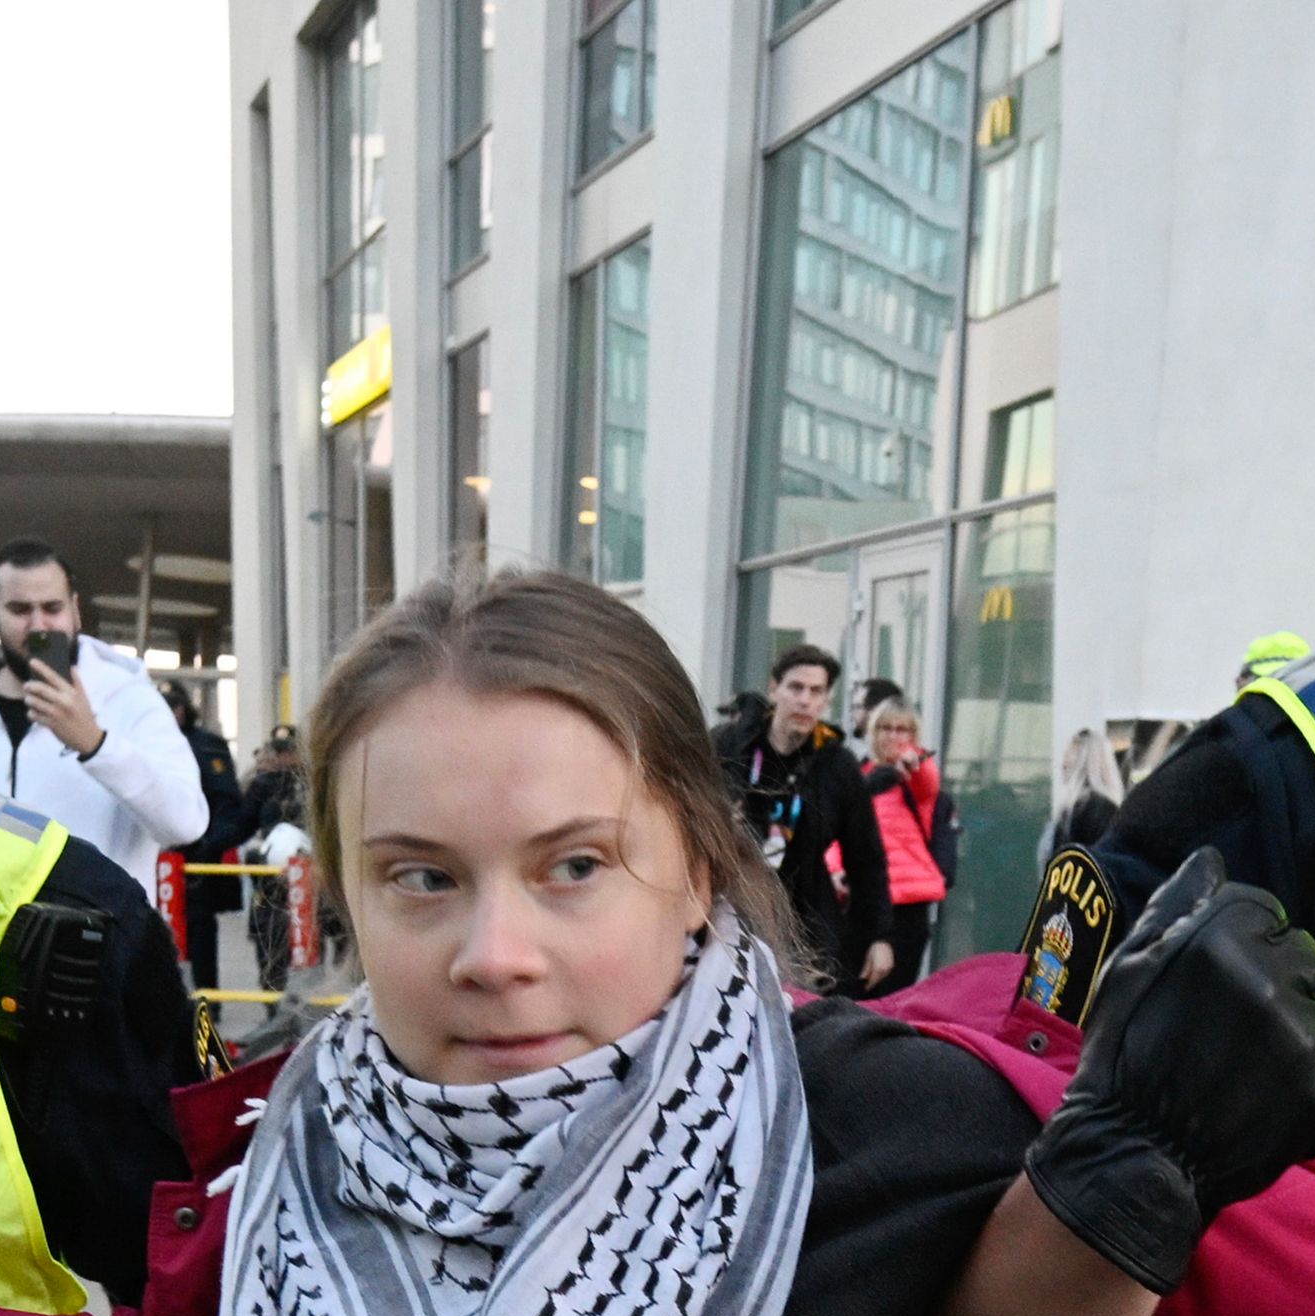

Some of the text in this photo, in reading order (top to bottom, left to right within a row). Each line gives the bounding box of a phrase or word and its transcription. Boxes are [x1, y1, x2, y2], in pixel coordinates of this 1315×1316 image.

[158, 861, 174, 924] POL
[287, 865, 306, 965] POLIS
[1047, 861, 1107, 928] POLIS
